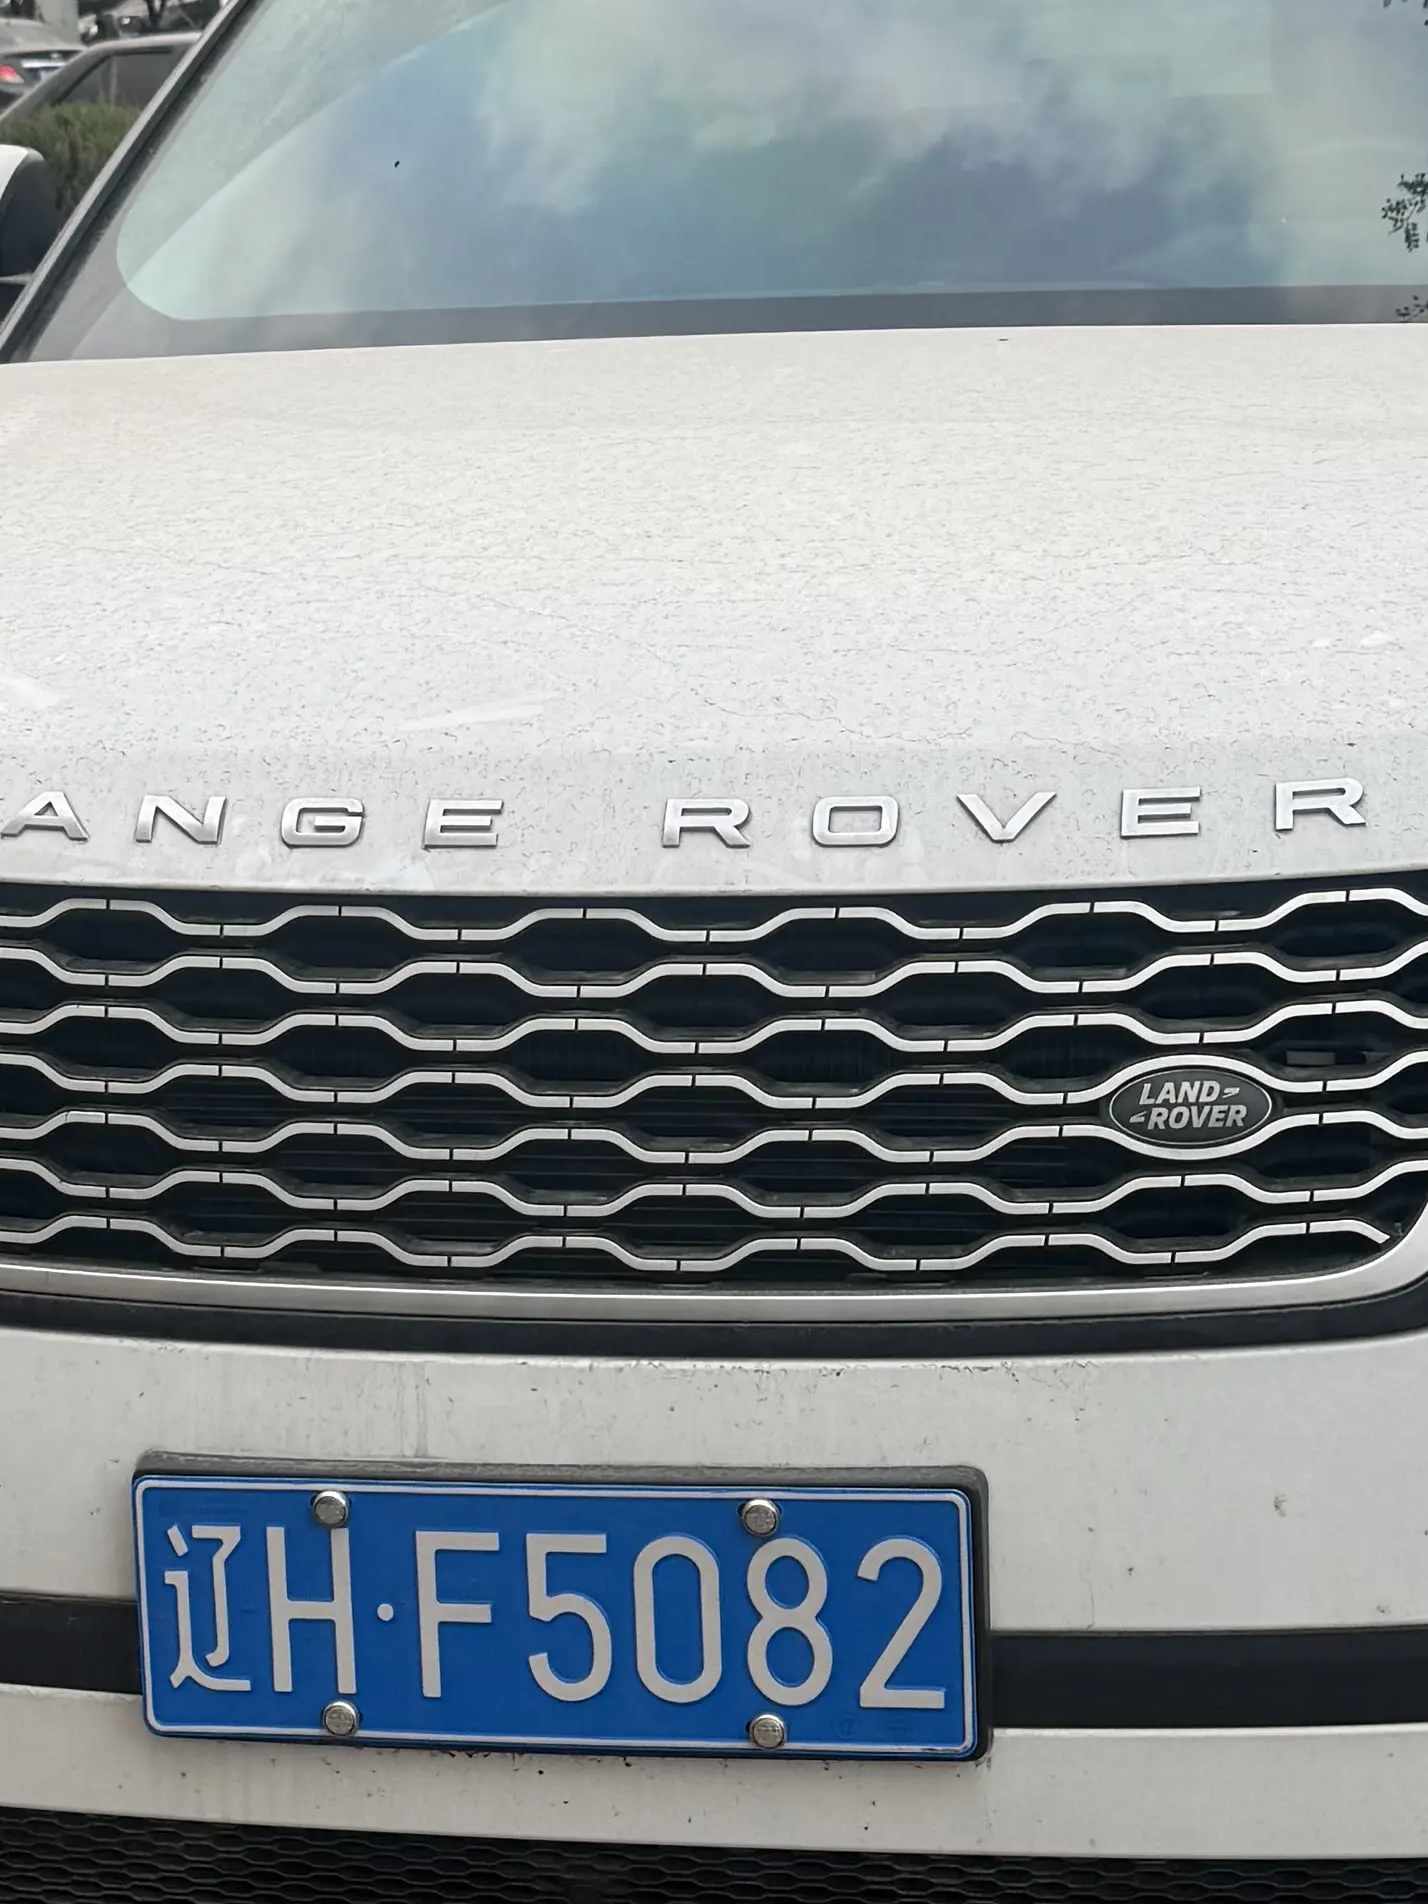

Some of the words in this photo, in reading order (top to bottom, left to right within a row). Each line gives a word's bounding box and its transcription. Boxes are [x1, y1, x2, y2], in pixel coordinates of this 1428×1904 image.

[662, 776, 1367, 849] ROVER
[1139, 1080, 1221, 1105] LAND
[1147, 1104, 1247, 1130] ROVER
